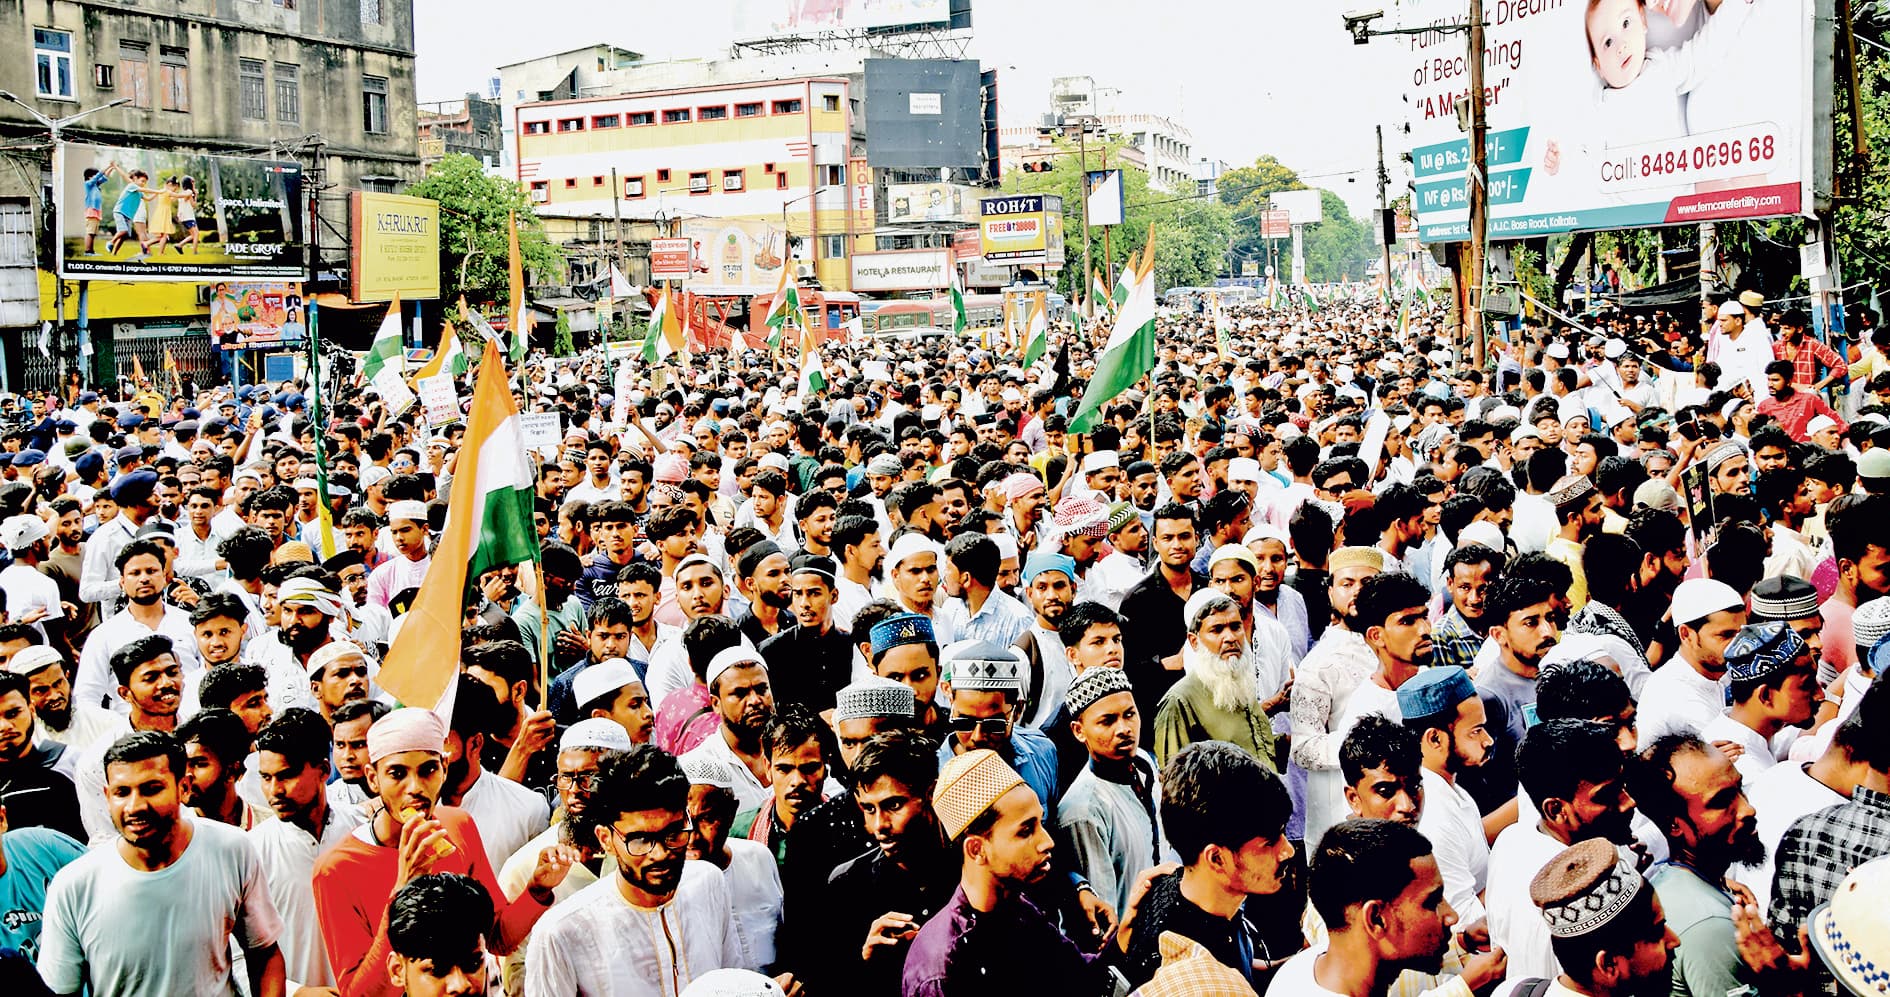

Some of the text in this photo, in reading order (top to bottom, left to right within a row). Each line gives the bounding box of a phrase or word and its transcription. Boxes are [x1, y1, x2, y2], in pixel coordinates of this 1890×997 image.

[1452, 8, 1491, 38] Yr
[1414, 39, 1521, 86] of Becing
[1439, 78, 1510, 118] Mer"
[1446, 149, 1461, 166] Rs.
[1601, 135, 1774, 182] Call: 8484 0696 68
[217, 196, 286, 208] Space, Unlimited.
[1424, 188, 1439, 206] IVF
[377, 213, 429, 233] KARUKRIT
[989, 223, 1006, 233] FREE
[1512, 219, 1528, 231] Bose
[223, 243, 284, 255] JADE GROVE
[891, 265, 942, 275] RESTAURANT
[4, 912, 43, 932] pum
